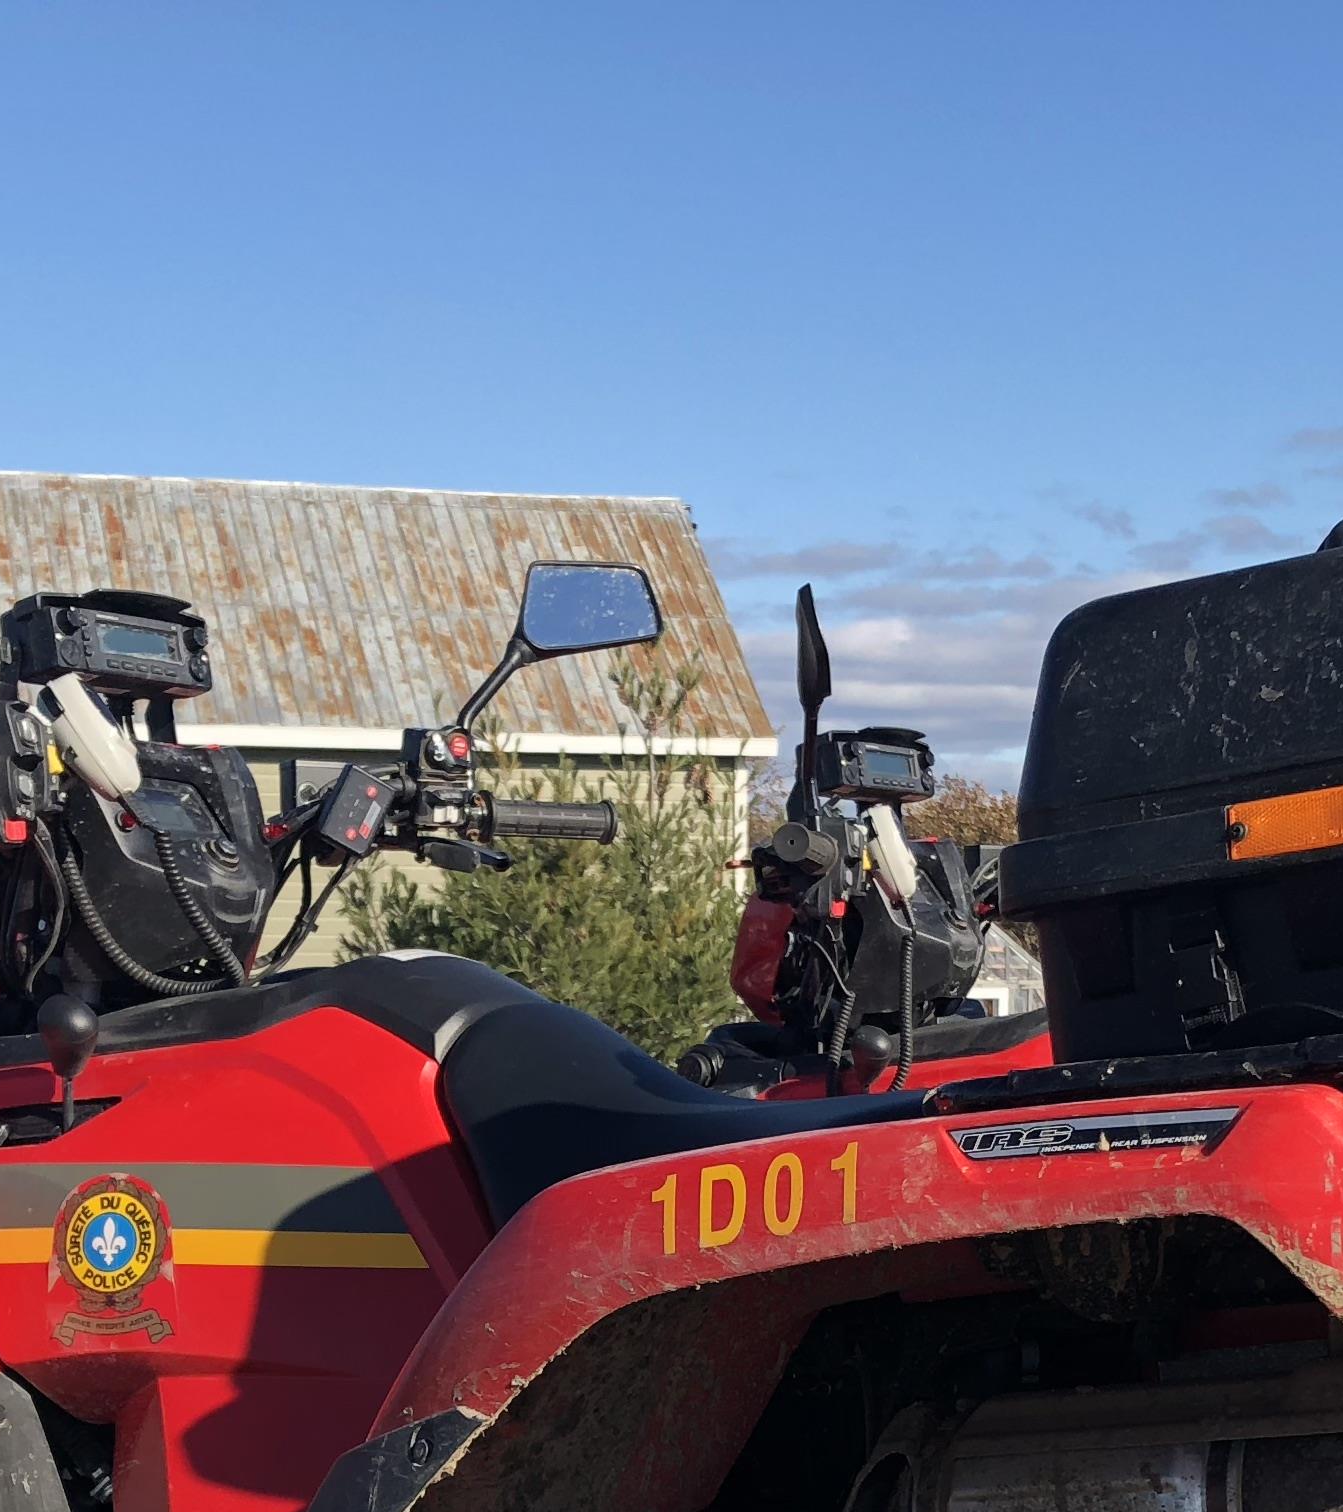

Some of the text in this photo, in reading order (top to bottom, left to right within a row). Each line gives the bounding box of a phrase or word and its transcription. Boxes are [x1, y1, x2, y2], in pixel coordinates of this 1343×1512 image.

[959, 1124, 1074, 1153] IRS
[1041, 1134, 1207, 1153] INDEPENDE REAR SUSPENSION
[67, 1196, 153, 1266] SÛRETÉ DU QUÉBEC
[82, 1267, 137, 1289] POLICE
